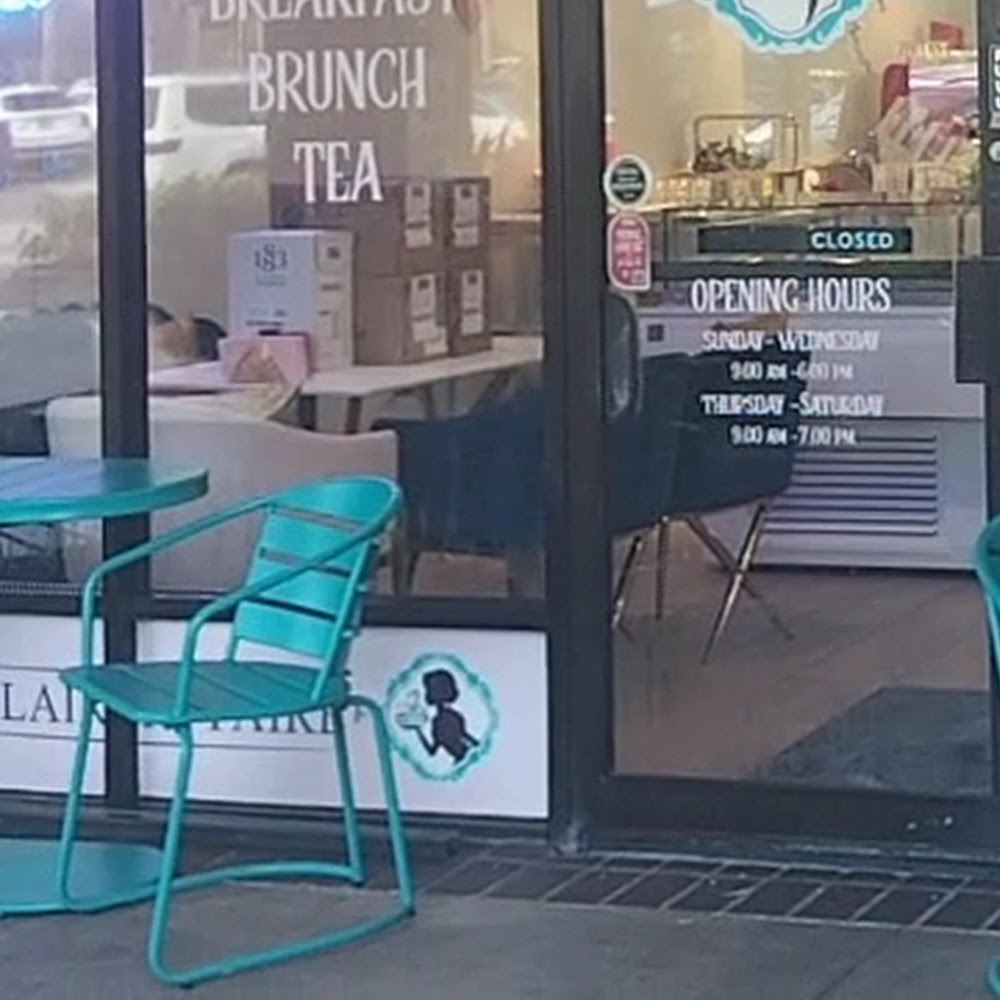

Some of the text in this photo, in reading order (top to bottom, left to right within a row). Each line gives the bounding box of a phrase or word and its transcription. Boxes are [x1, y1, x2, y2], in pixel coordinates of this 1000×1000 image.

[248, 47, 427, 112] BRUNCH
[293, 141, 384, 204] TEA
[810, 231, 894, 250] CLOSED
[691, 276, 892, 314] OPENING HOURS
[702, 330, 765, 350] SUNDAY
[701, 394, 785, 415] THURSDAY
